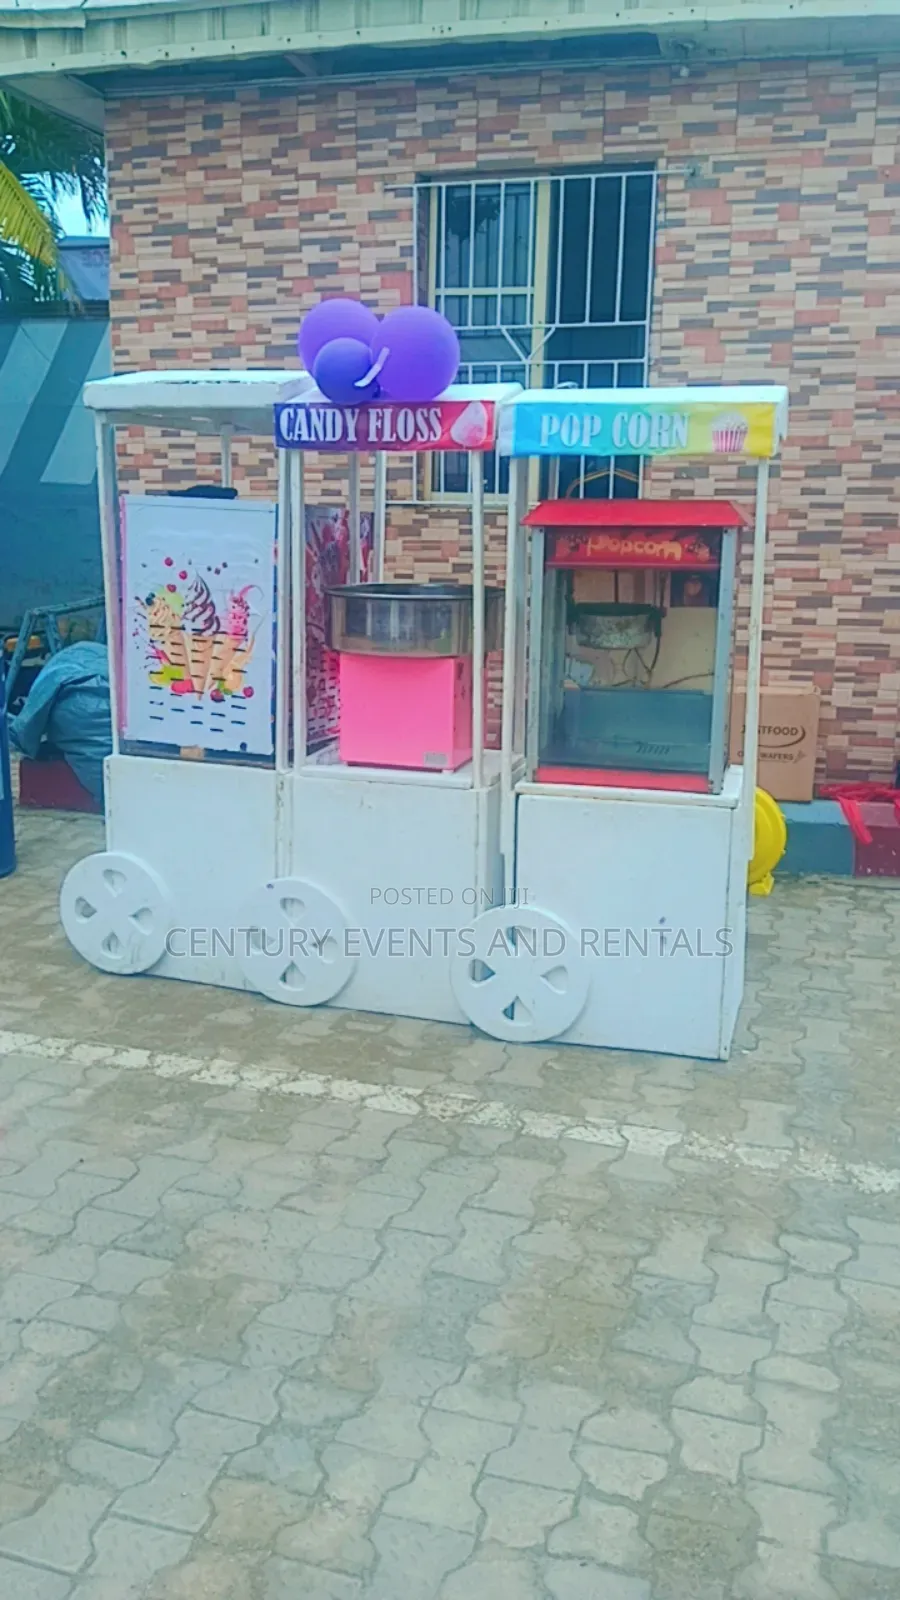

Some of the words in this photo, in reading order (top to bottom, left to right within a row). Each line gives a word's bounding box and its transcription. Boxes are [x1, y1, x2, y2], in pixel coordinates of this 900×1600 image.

[279, 407, 360, 442] CANDY
[367, 407, 442, 442] FLOSS
[539, 412, 601, 448] POP
[612, 411, 691, 449] CORN
